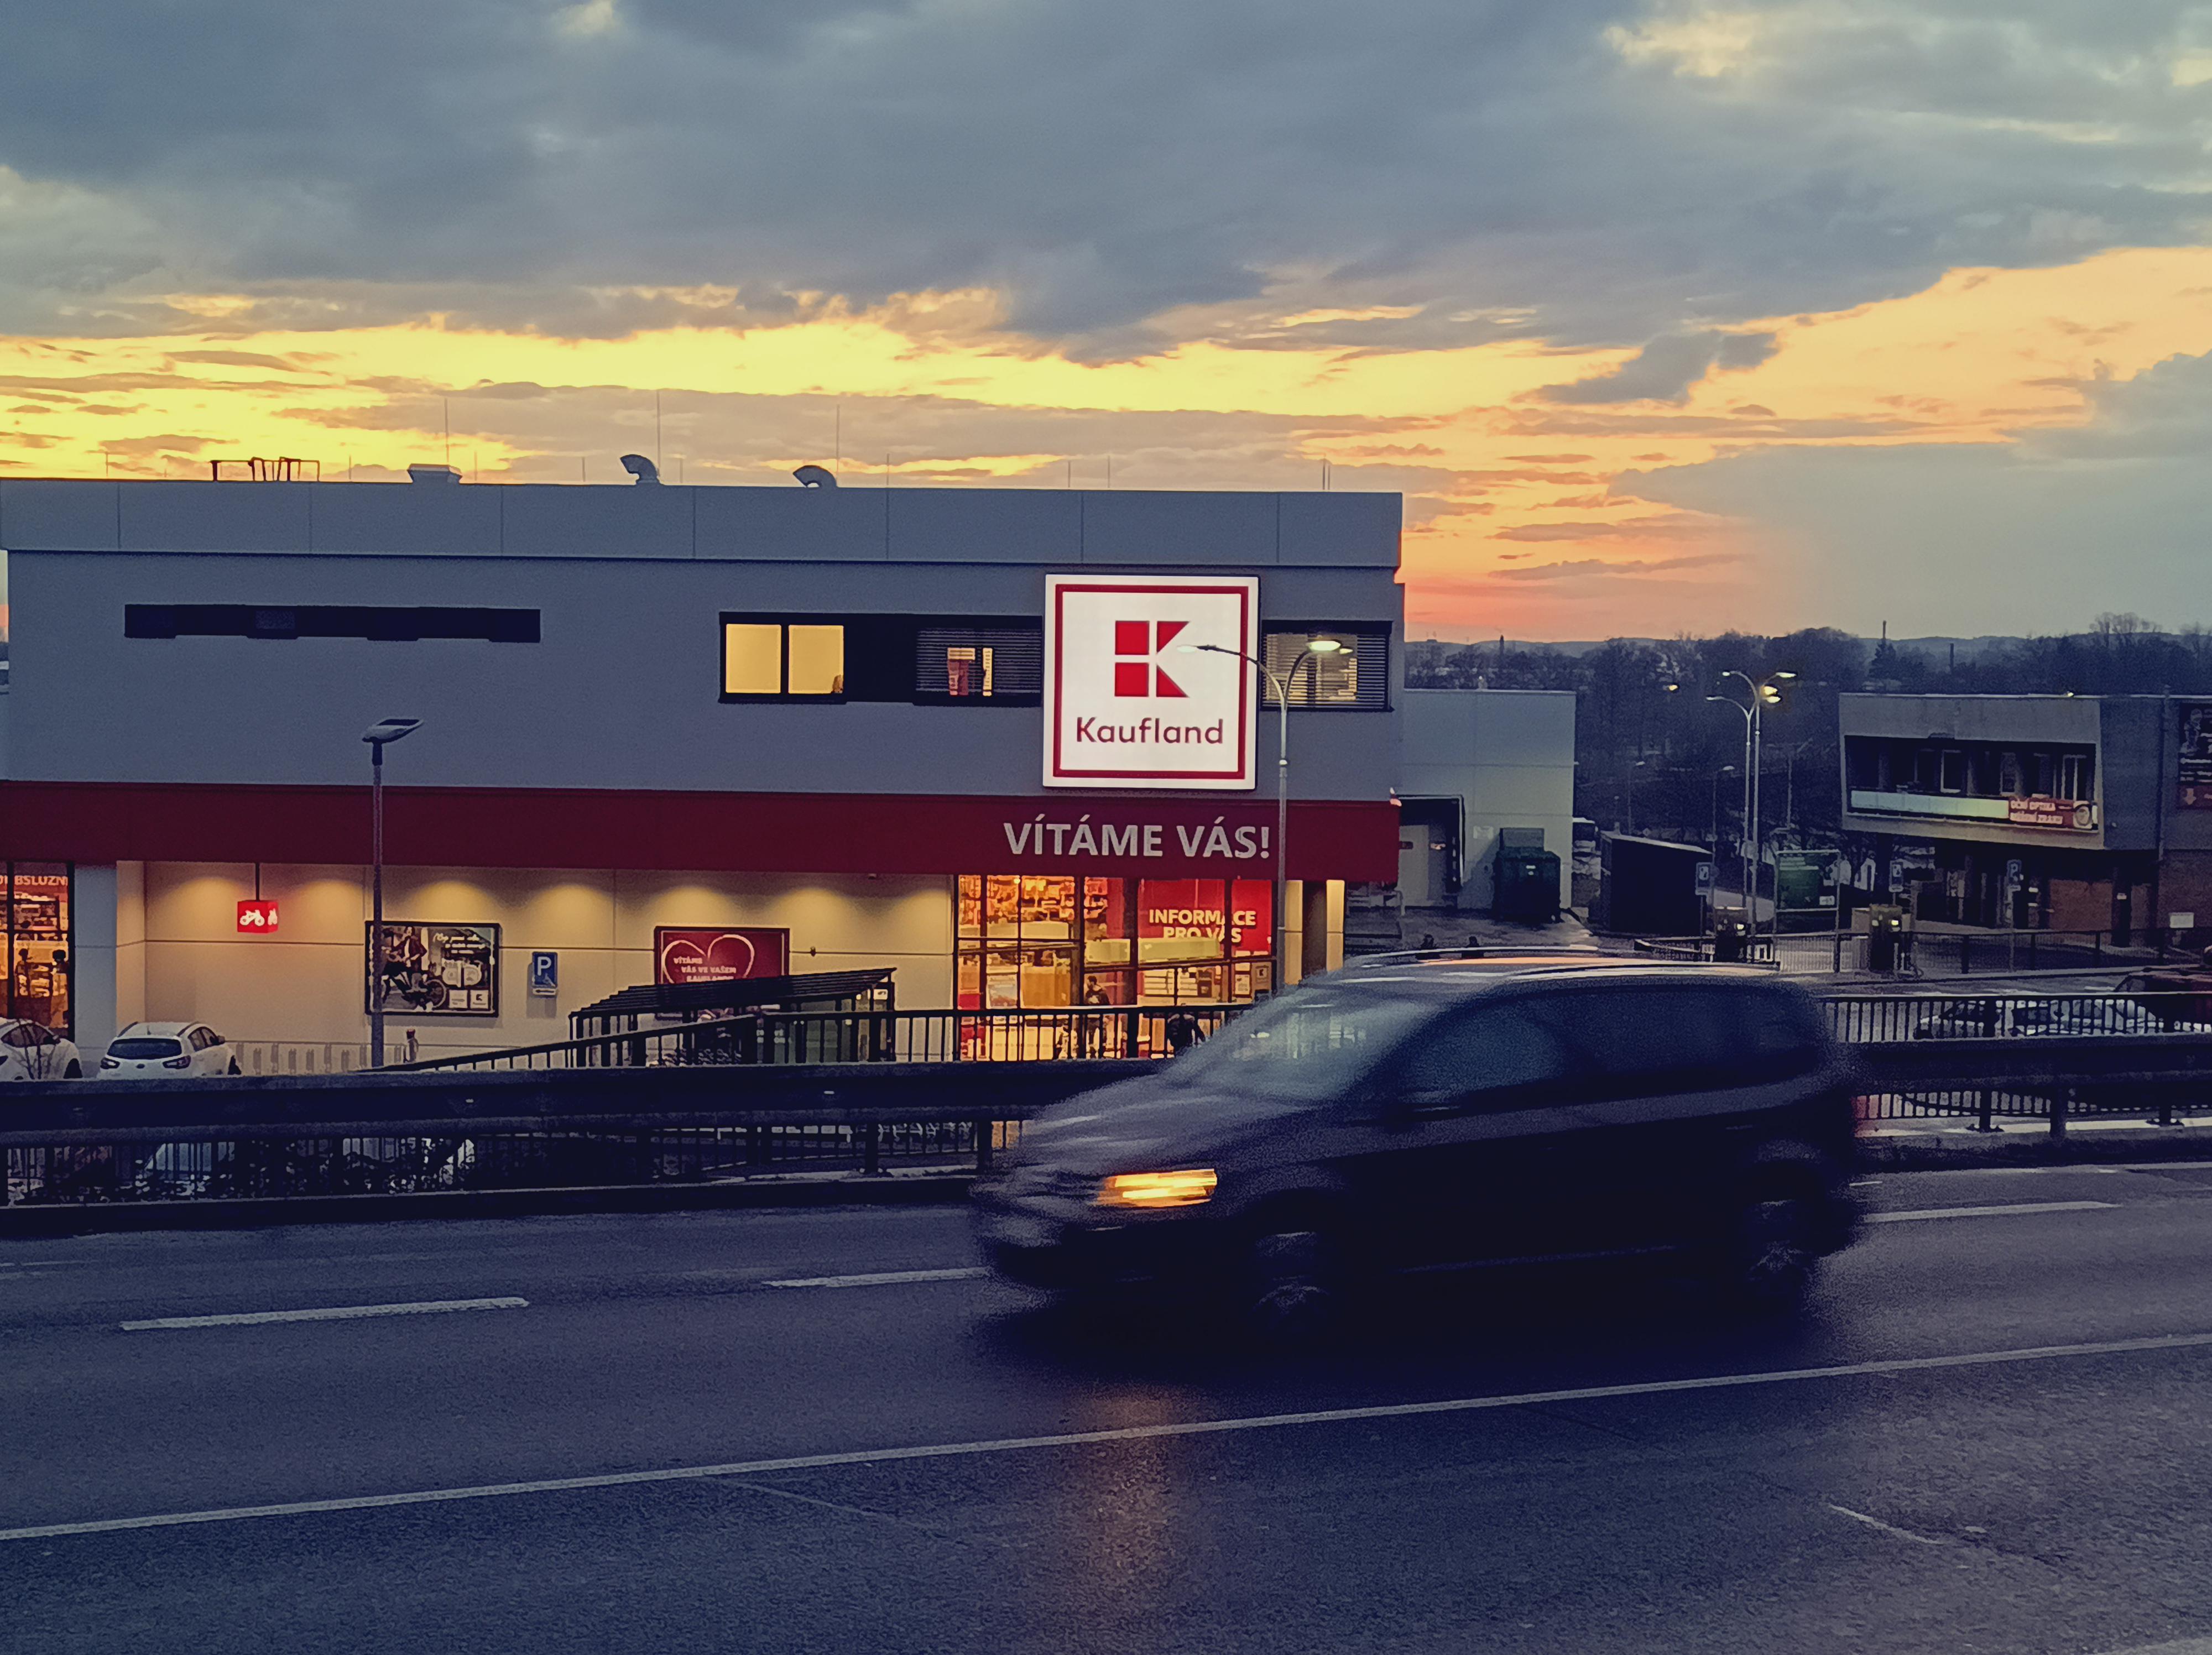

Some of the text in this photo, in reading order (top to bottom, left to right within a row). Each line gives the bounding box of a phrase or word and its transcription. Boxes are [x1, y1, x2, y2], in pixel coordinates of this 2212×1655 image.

[1076, 717, 1223, 744] Kaufland
[1003, 813, 1270, 859] VÍTÁME VÁS!
[537, 956, 552, 976] P
